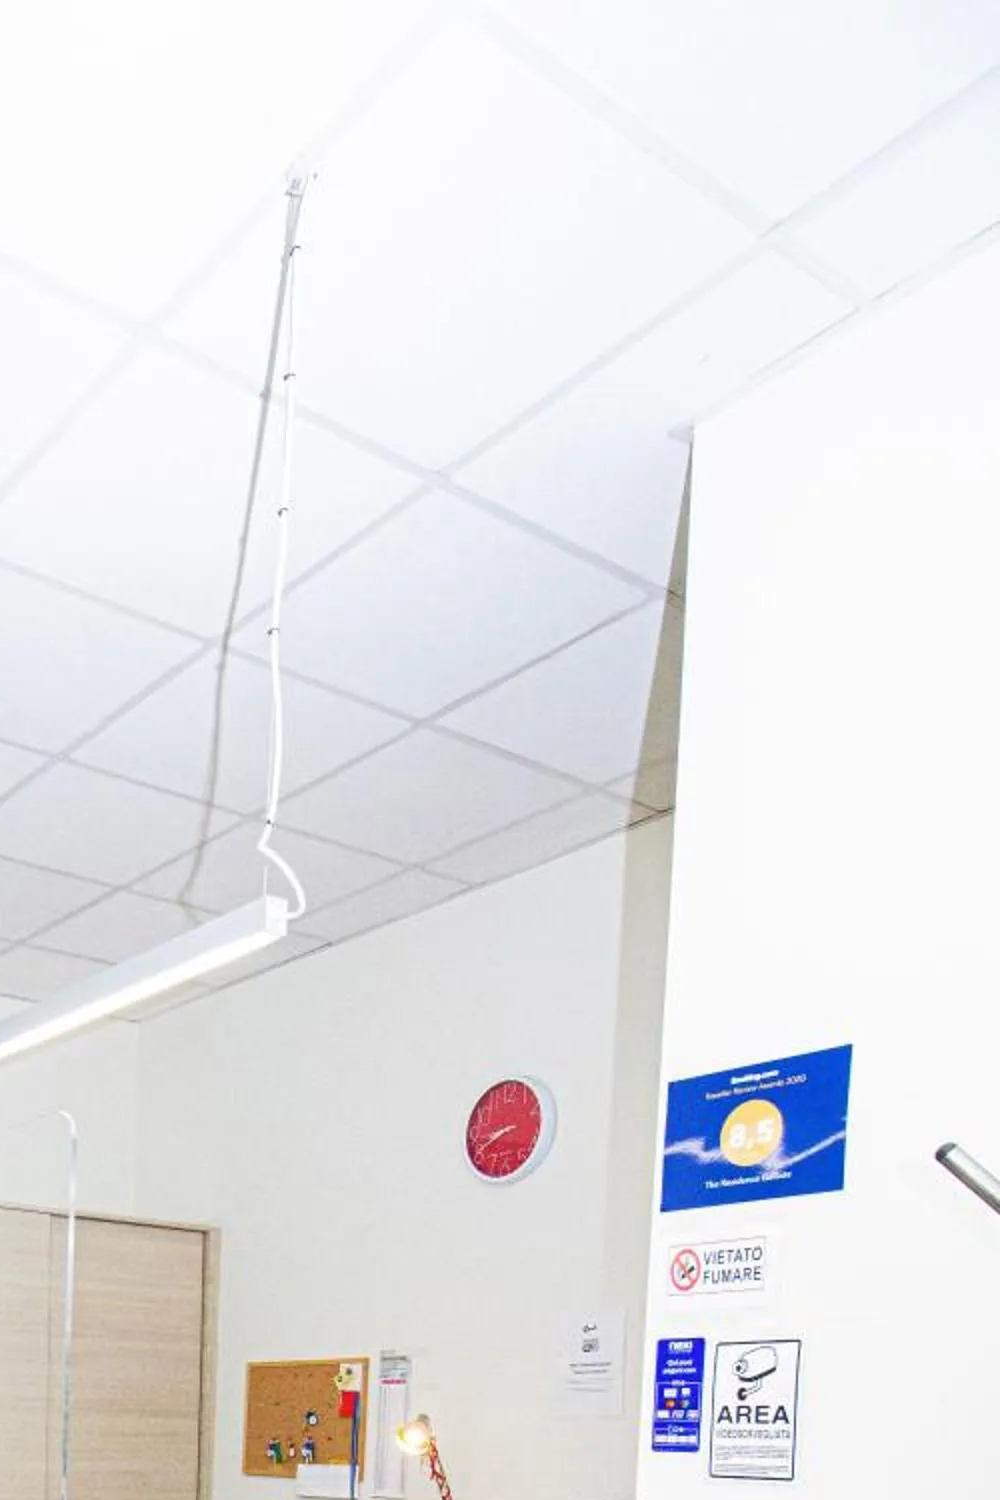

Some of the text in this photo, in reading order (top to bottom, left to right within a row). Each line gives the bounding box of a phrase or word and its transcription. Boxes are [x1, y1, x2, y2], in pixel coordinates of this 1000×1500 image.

[703, 1246, 763, 1265] VIETATO
[703, 1266, 762, 1285] FUMARE
[717, 1405, 790, 1424] AREA
